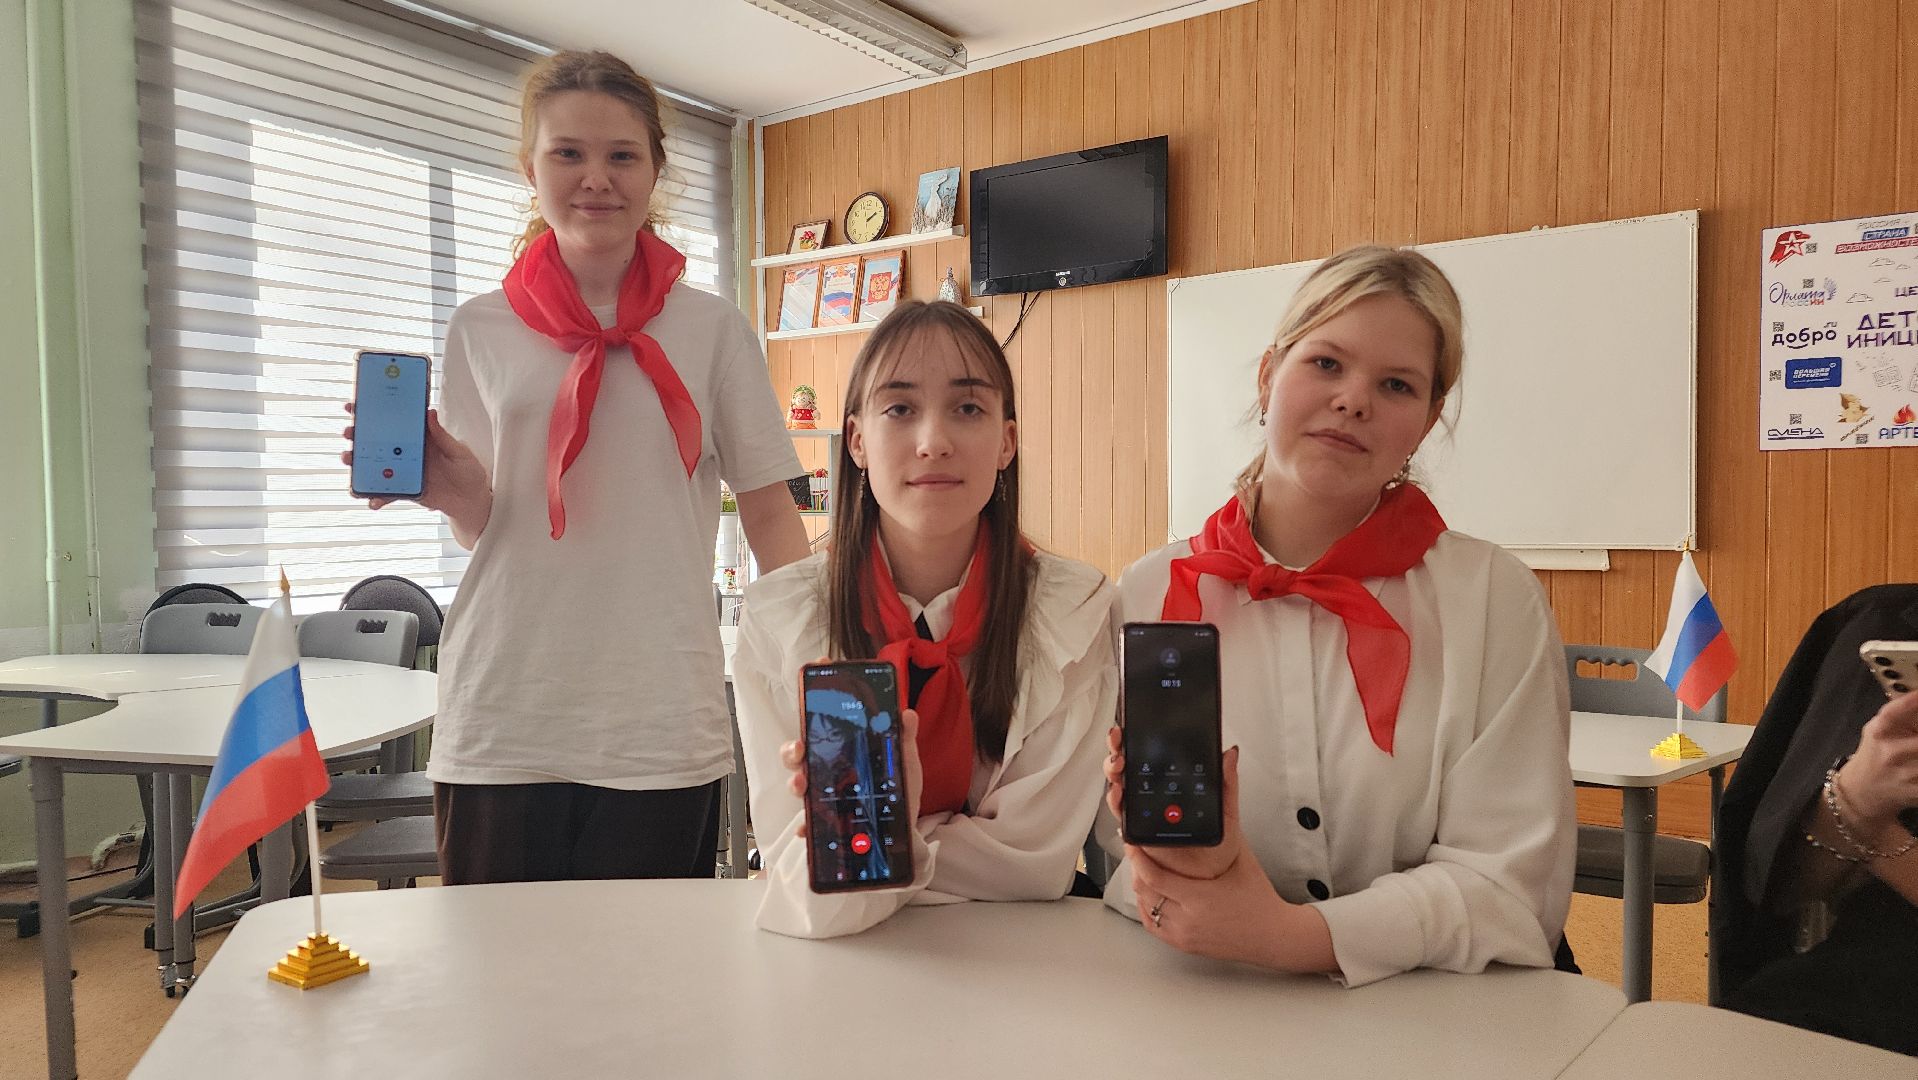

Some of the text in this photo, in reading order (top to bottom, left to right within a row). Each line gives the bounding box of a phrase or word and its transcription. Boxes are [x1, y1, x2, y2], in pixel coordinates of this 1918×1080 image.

[1864, 228, 1907, 240] СТРАНА
[1768, 281, 1825, 305] Орлята
[1895, 286, 1918, 298] ЦЕ
[1857, 310, 1918, 330] ДЕТ
[1771, 327, 1837, 347] добро
[1847, 330, 1918, 348] ИНИЦ
[1767, 427, 1824, 437] СМЕНА
